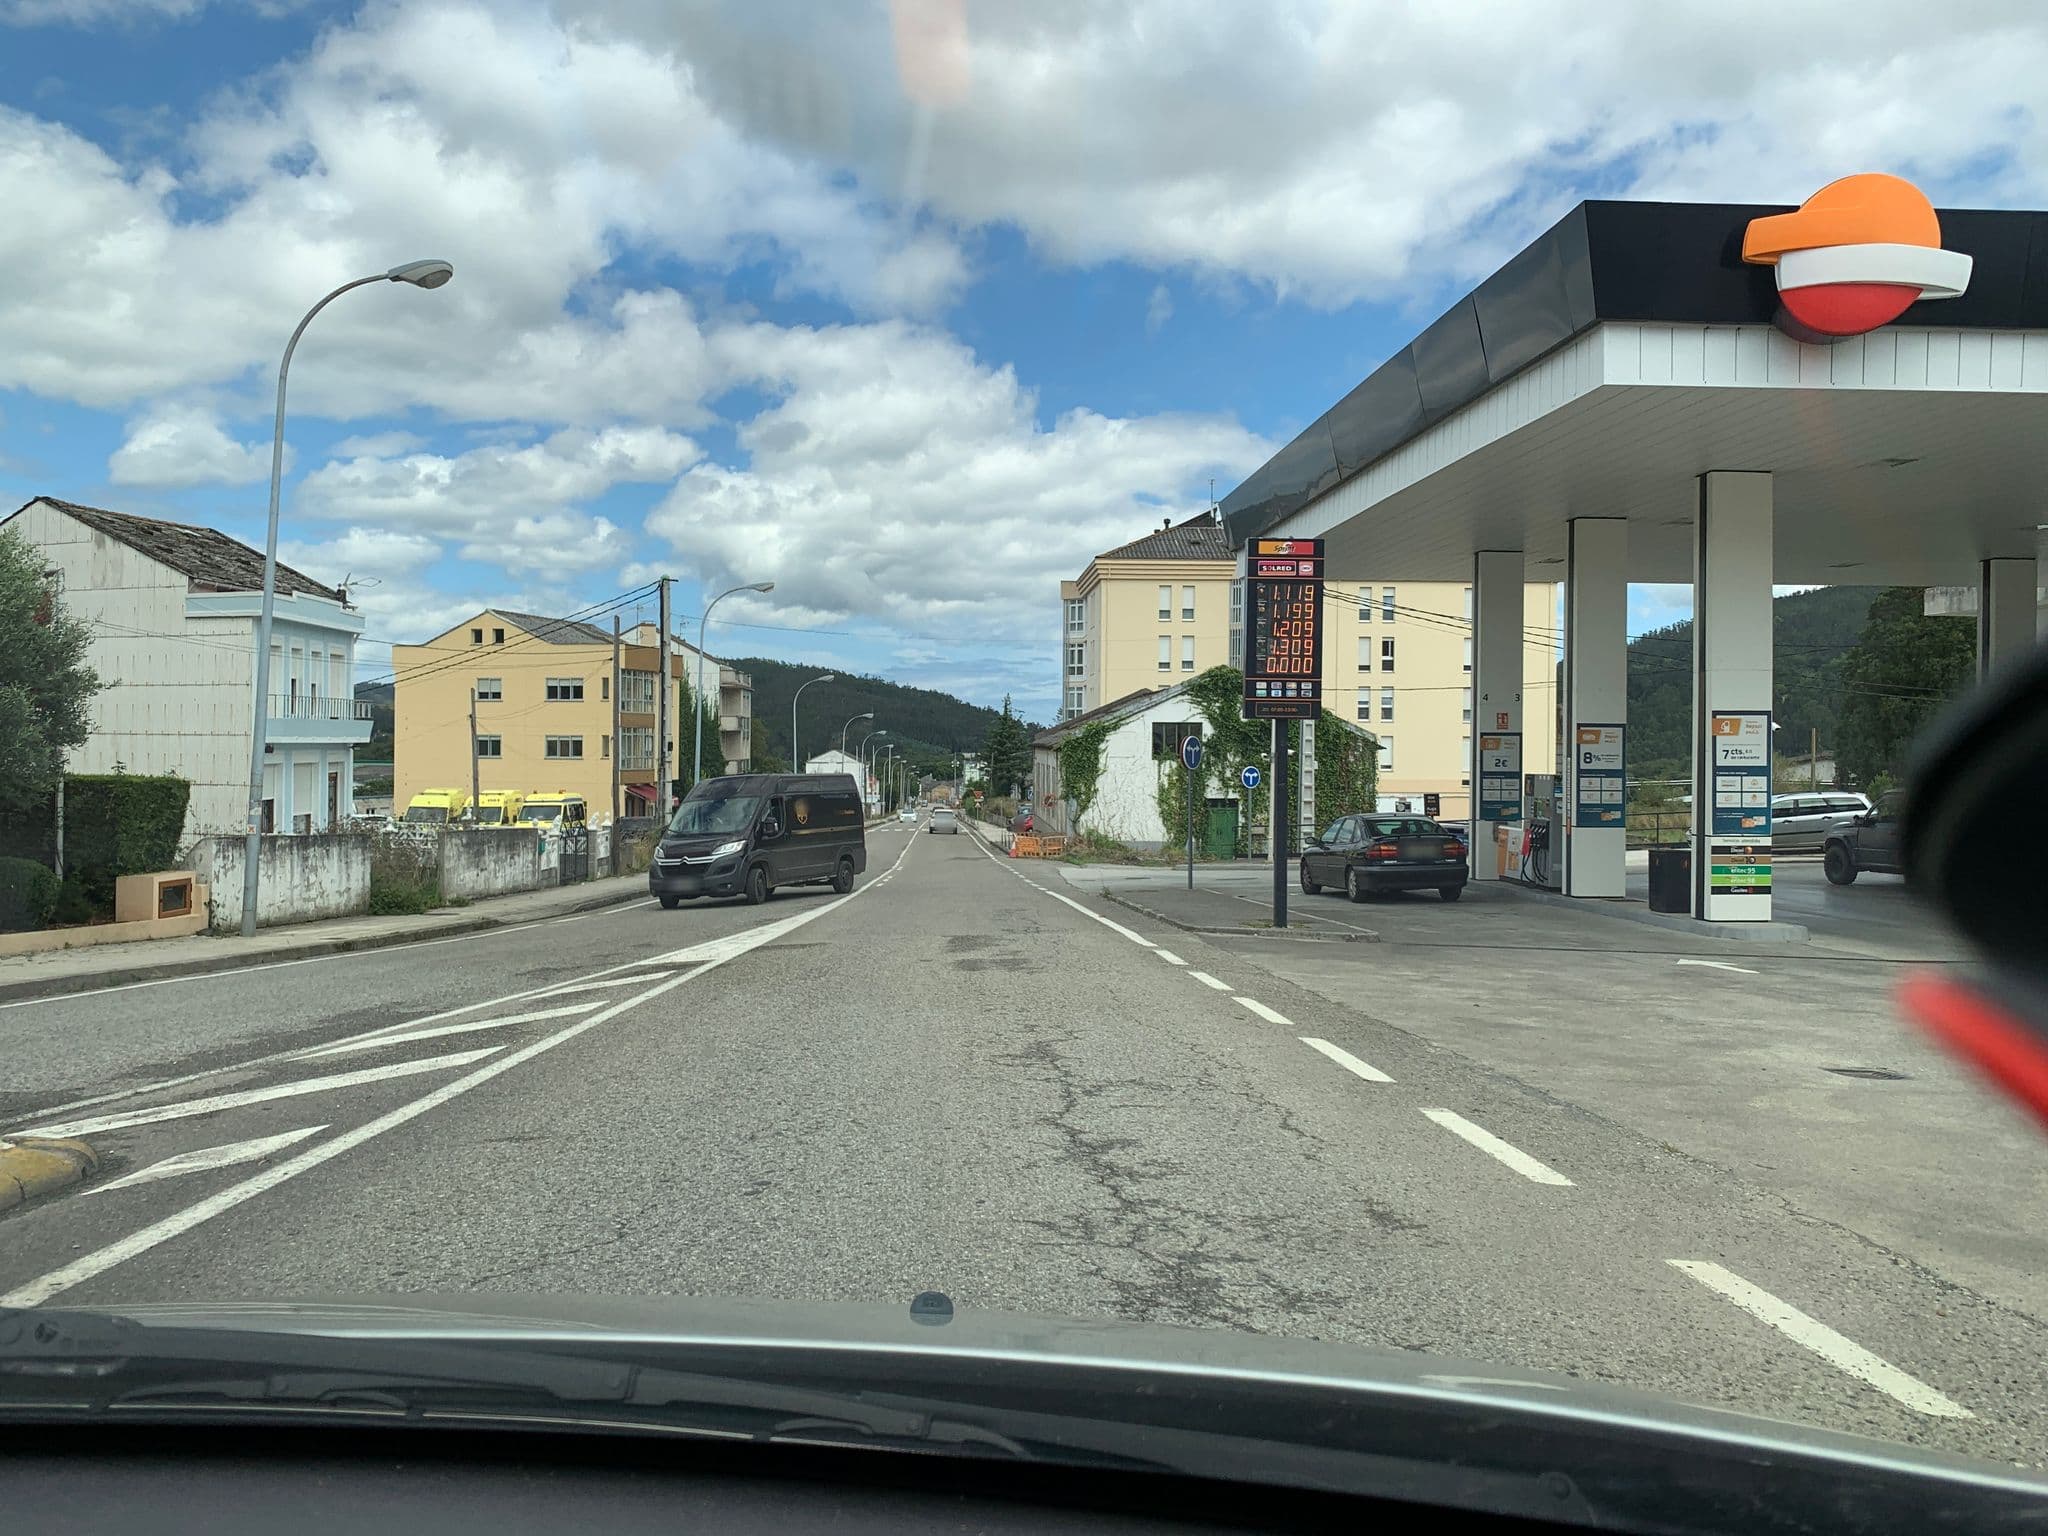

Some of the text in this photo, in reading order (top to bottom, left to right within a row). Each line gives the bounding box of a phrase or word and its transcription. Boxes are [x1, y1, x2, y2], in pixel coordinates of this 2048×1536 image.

[1273, 585, 1314, 601] 1.119
[1273, 603, 1314, 619] 1.199
[1273, 621, 1314, 637] 1.209
[1273, 639, 1314, 655] 1.309
[1266, 657, 1313, 673] 0.000
[1482, 693, 1489, 702] 4
[1514, 693, 1521, 702] 3
[1722, 749, 1730, 760] 7
